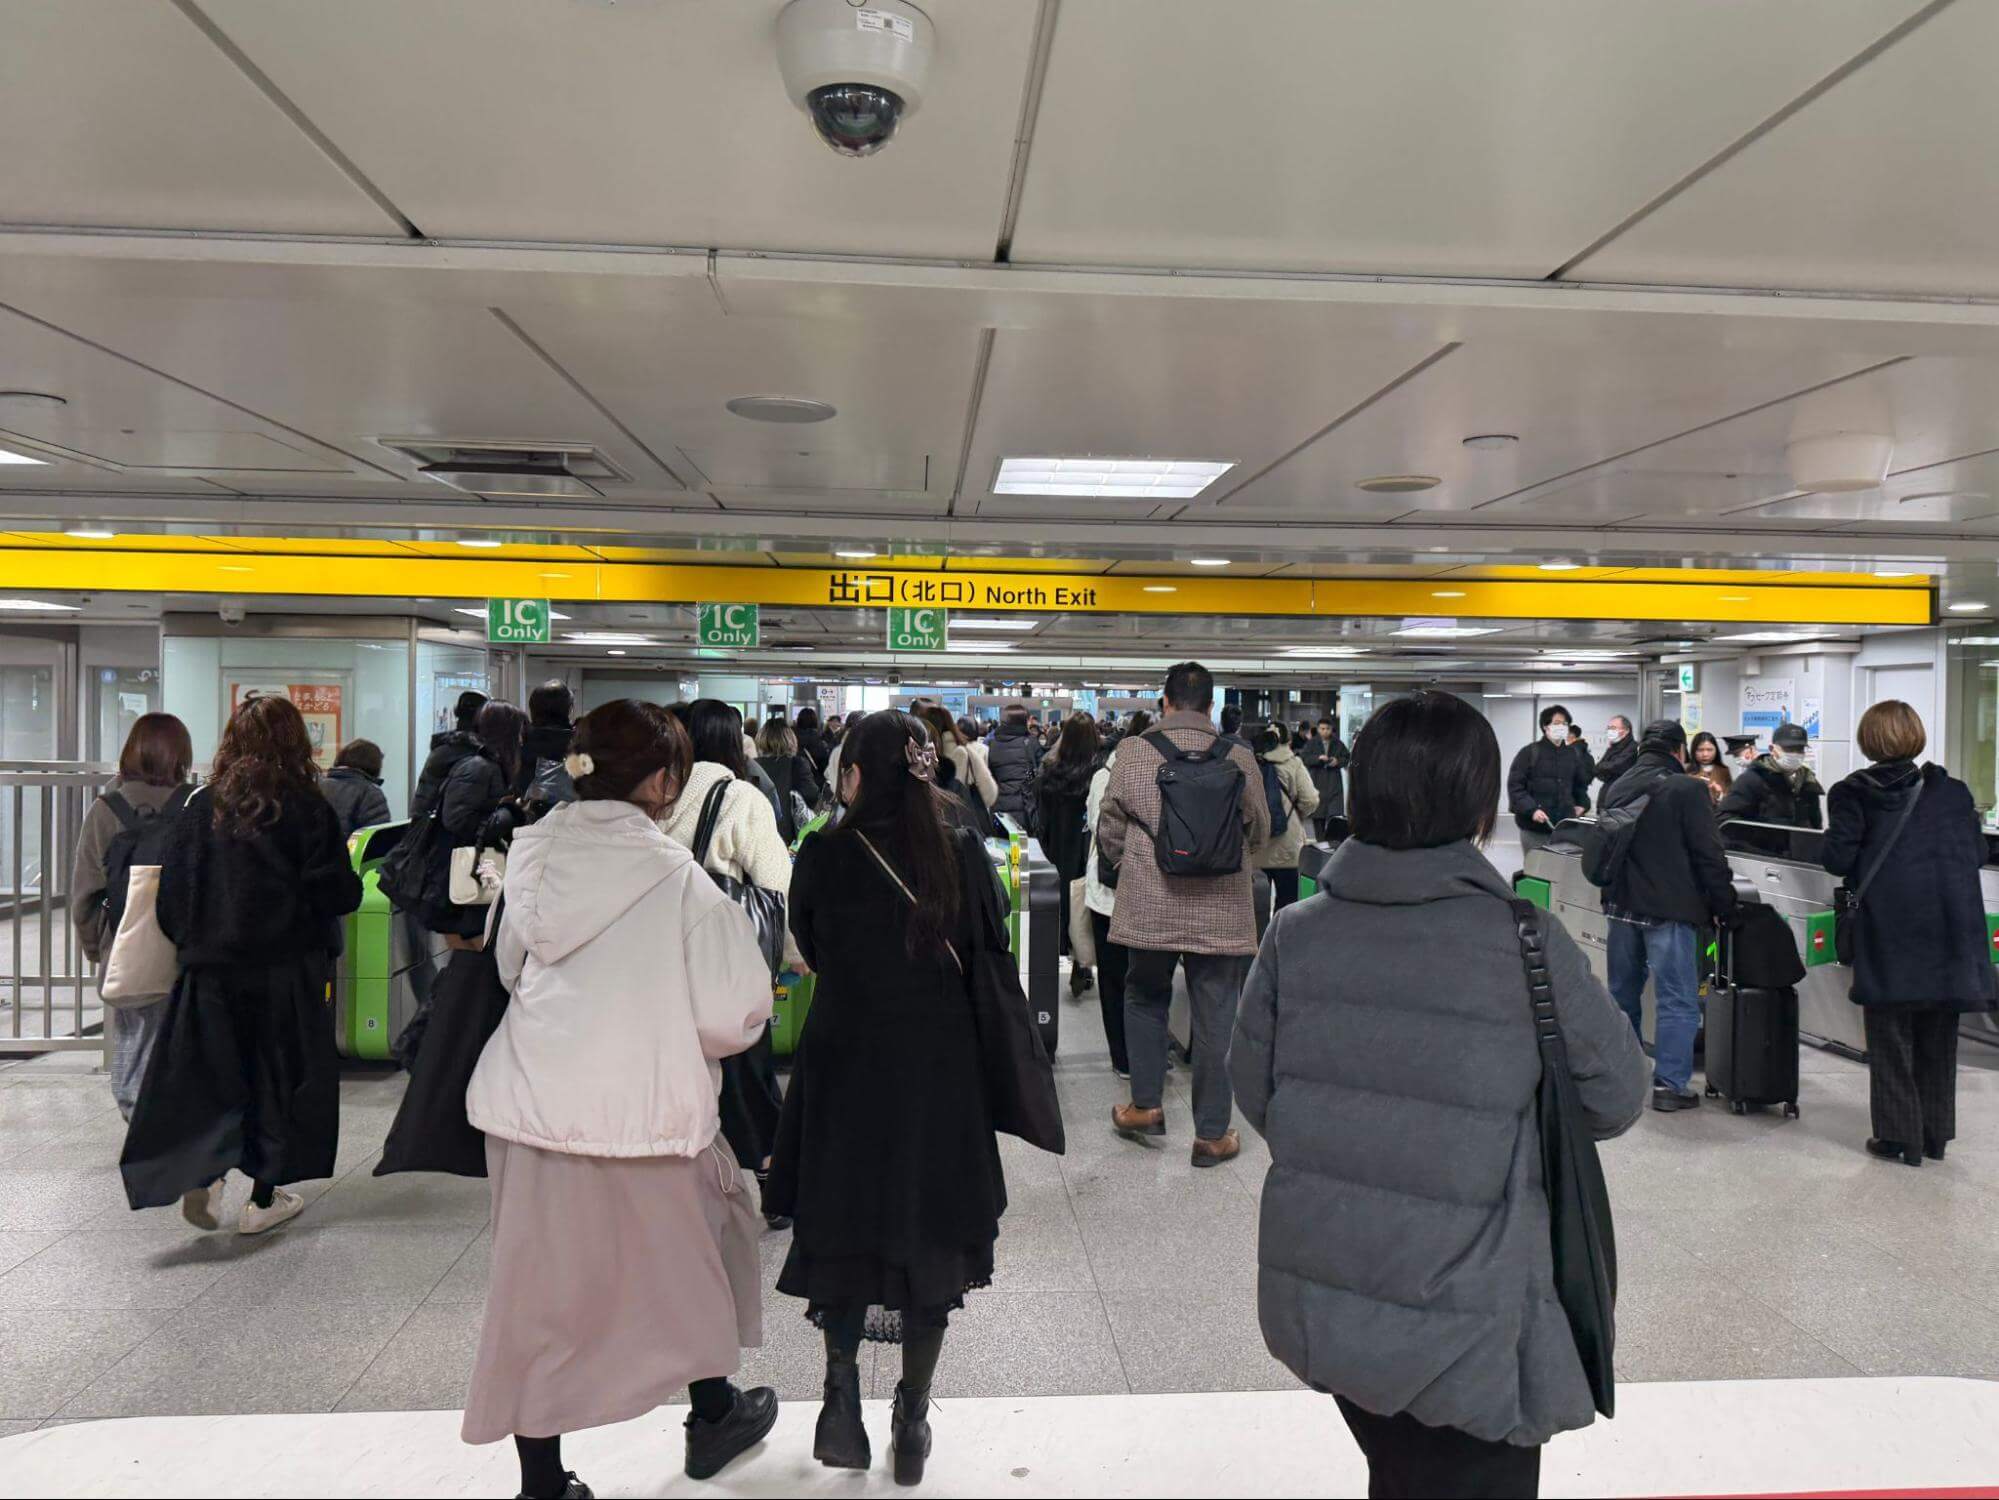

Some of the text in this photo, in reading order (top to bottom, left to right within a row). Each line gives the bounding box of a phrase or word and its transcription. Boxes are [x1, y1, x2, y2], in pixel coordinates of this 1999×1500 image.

[986, 587, 1046, 605] North
[1055, 587, 1096, 606] Exit
[503, 601, 537, 625] IC
[713, 605, 745, 630] IC
[903, 609, 934, 633] IC
[497, 625, 543, 641] Only
[707, 630, 752, 645] Only
[896, 634, 940, 649] Only
